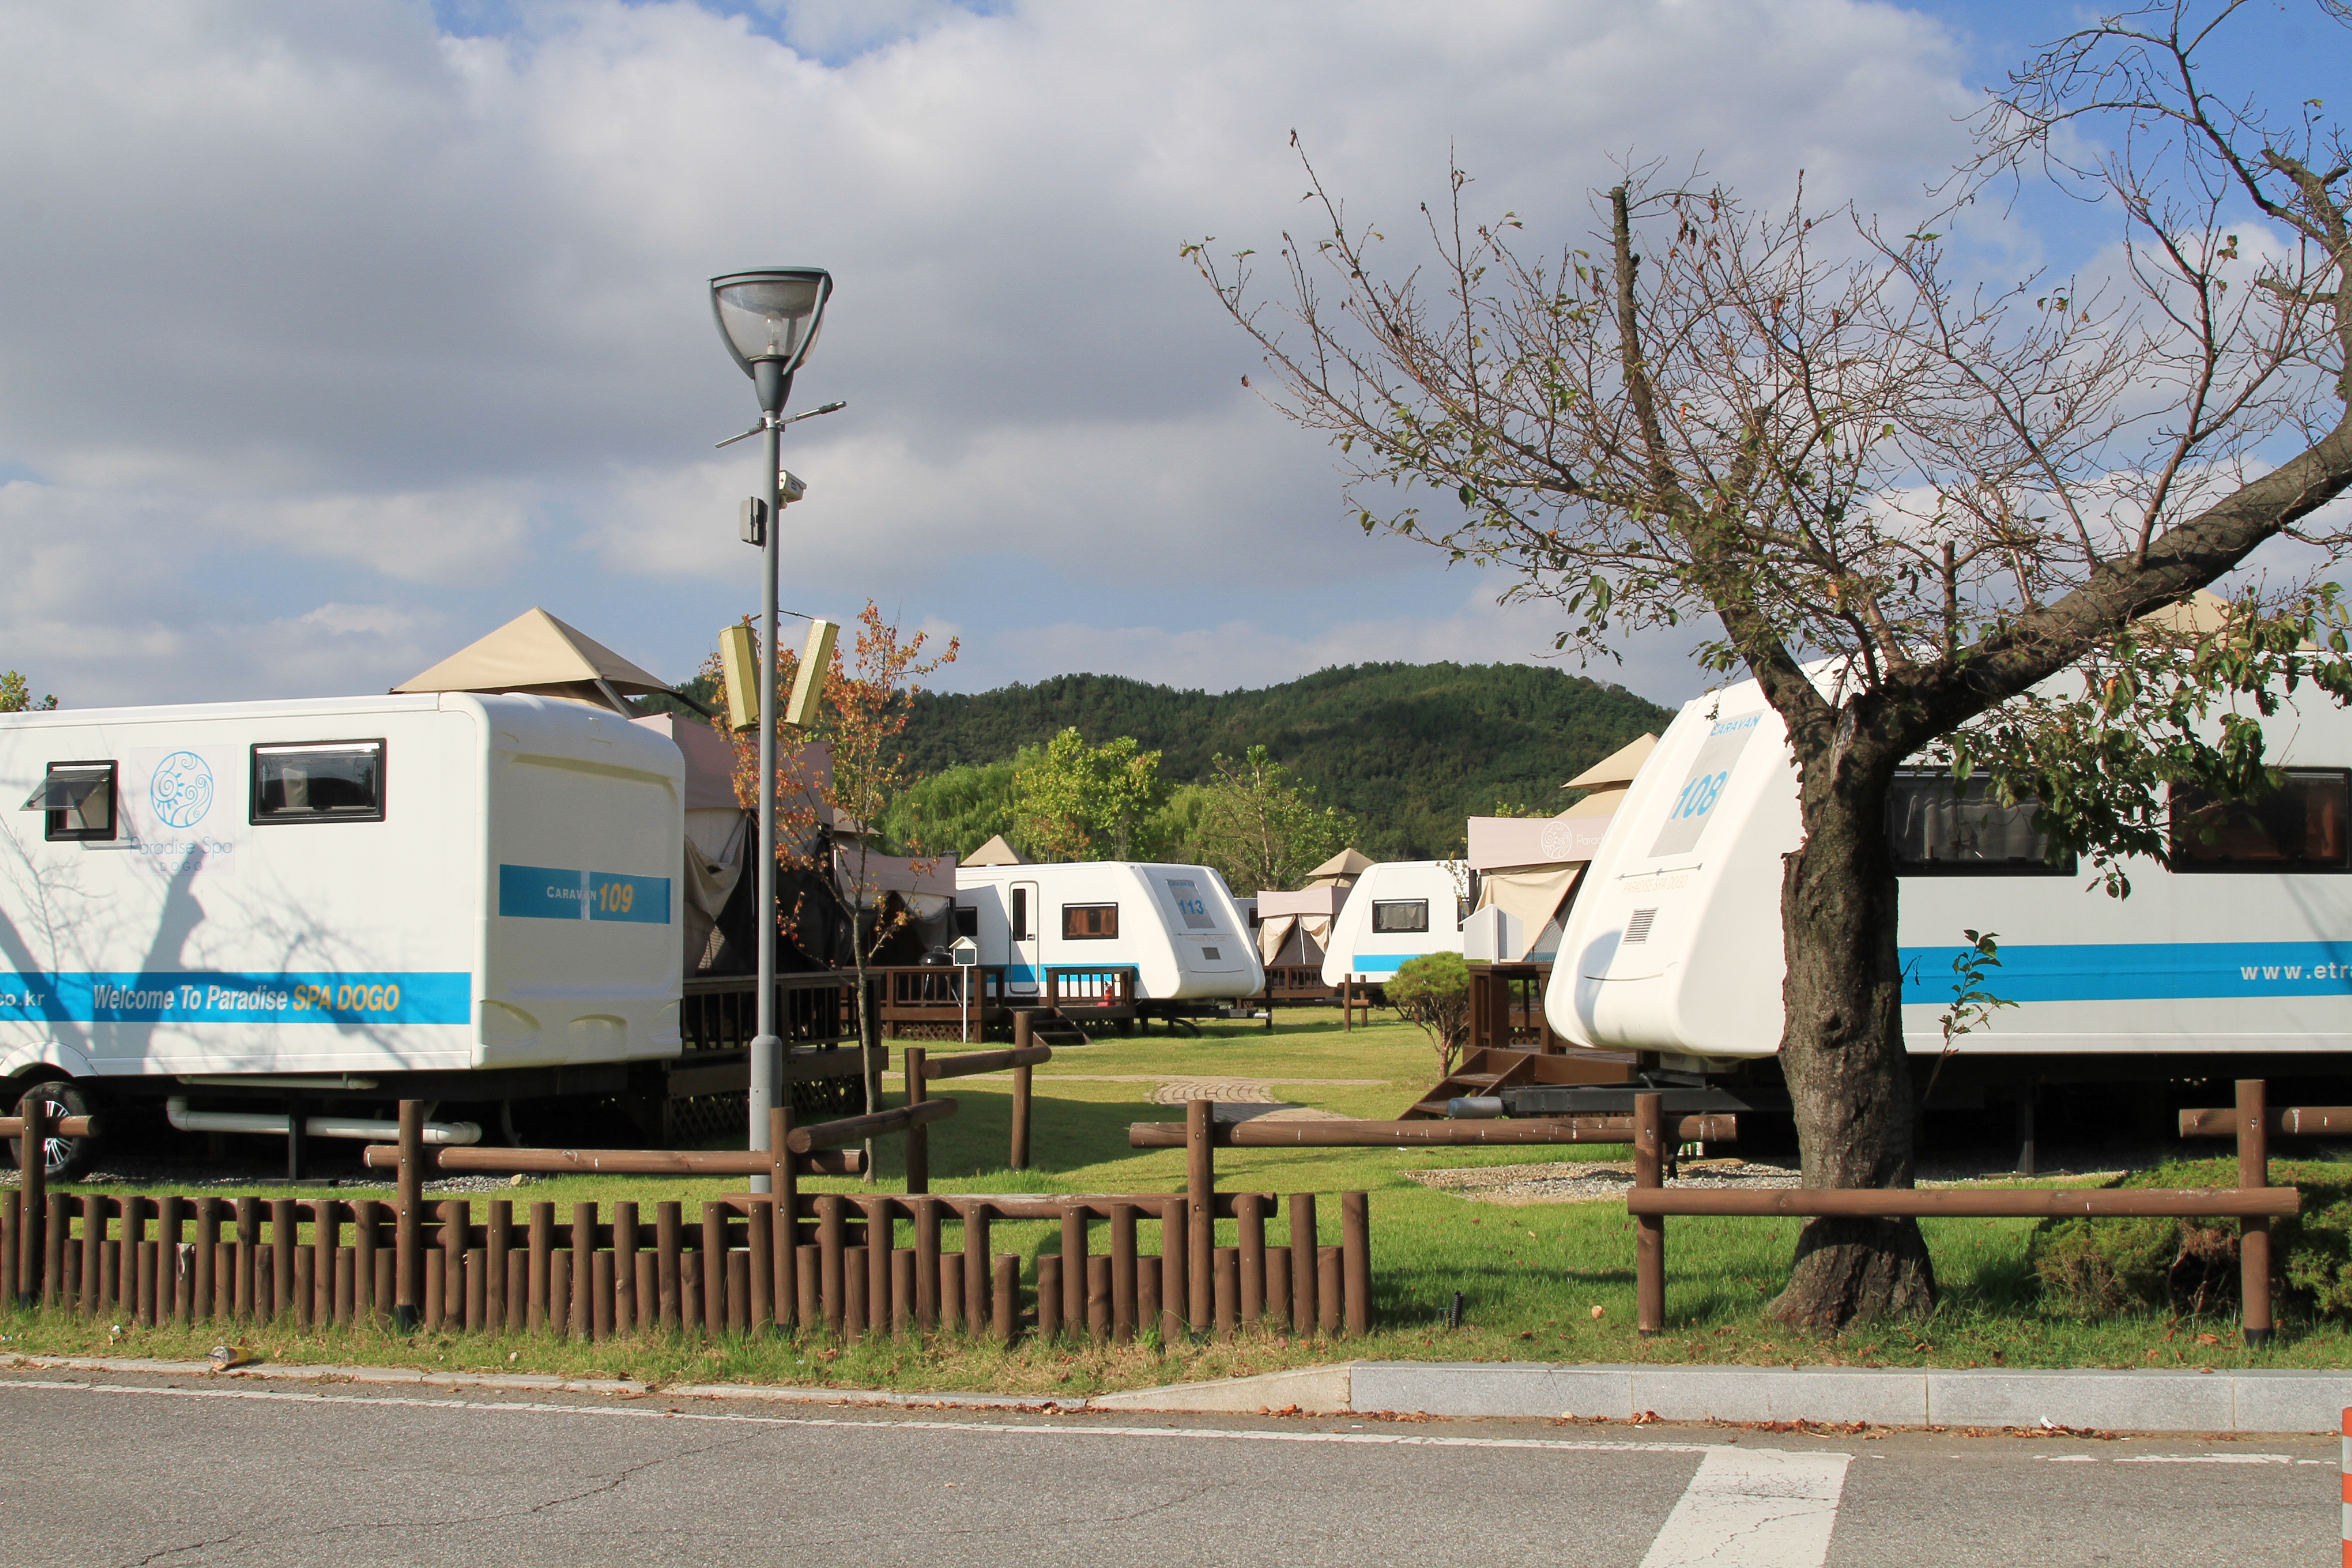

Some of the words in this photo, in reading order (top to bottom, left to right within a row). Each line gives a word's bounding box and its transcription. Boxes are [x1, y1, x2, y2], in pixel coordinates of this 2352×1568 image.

[1710, 715, 1761, 737] CARAVAN
[1671, 770, 1727, 819] 108
[130, 836, 195, 855] Paradise
[202, 836, 232, 859] Spa
[160, 861, 202, 871] DOGO
[1622, 879, 1654, 894] PARADISE
[1653, 877, 1667, 891] SPA
[1667, 875, 1688, 889] DOGO
[600, 883, 634, 913] 109
[1179, 900, 1204, 914] 113
[2240, 962, 2352, 980] www.etr
[93, 985, 175, 1009] Welcome
[180, 985, 201, 1009] To
[206, 985, 288, 1010] Paradise
[293, 985, 331, 1010] SPA
[337, 984, 400, 1011] DOGO
